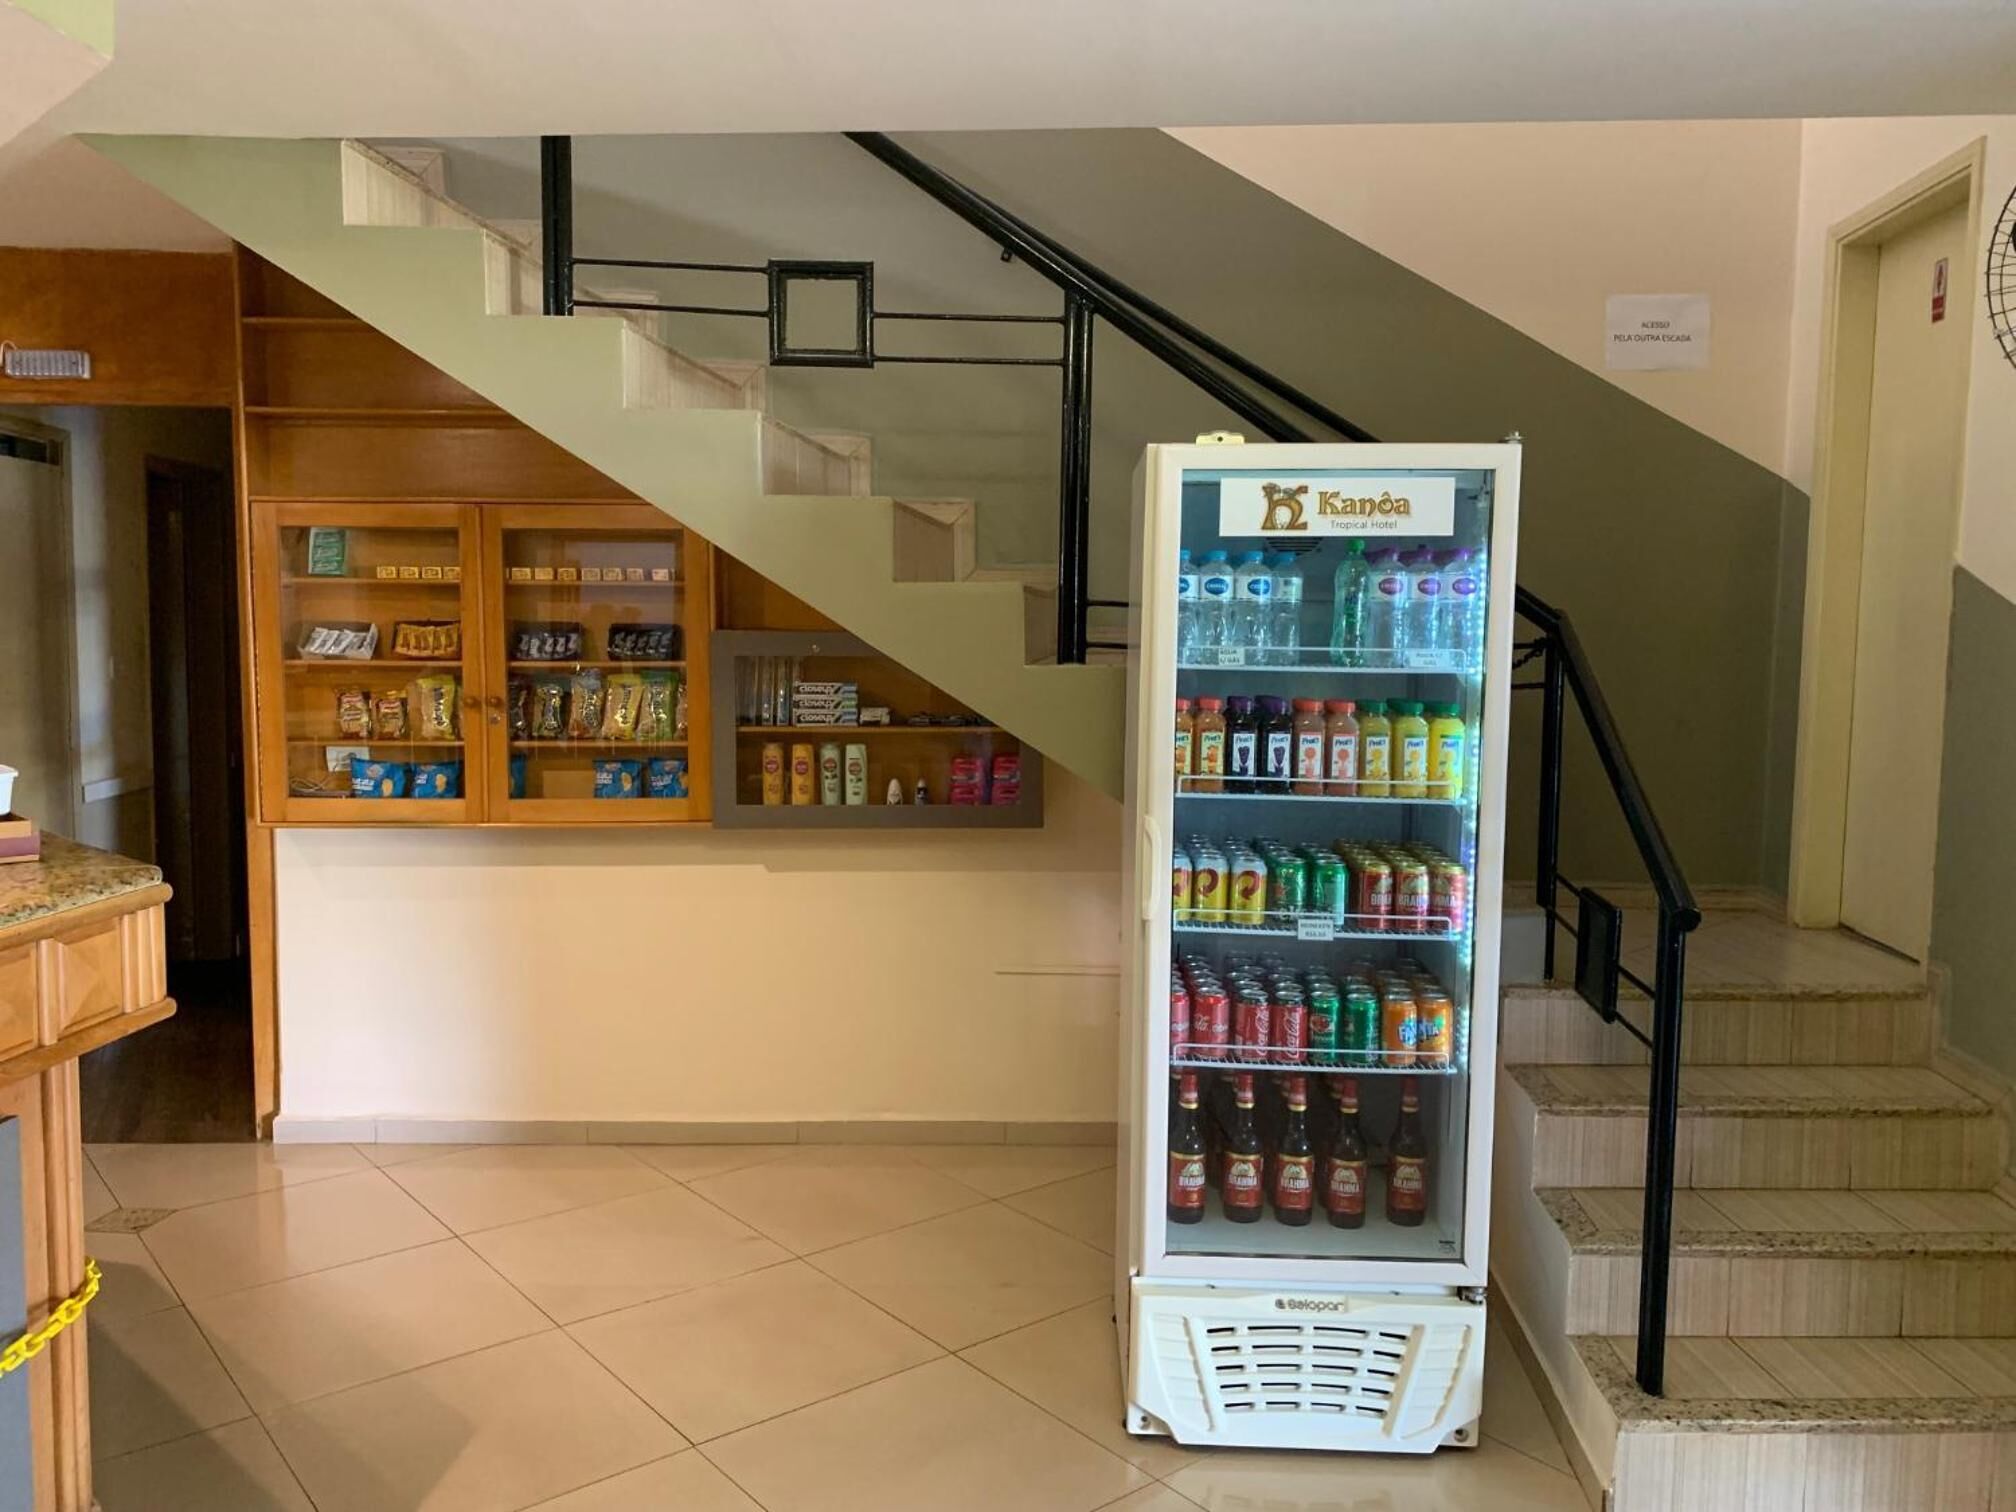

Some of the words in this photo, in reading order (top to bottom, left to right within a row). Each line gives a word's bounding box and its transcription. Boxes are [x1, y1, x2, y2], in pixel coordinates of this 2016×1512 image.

[1641, 321, 1671, 329] ACESSO
[1613, 334, 1633, 342] PELA
[1634, 334, 1660, 342] OUTRA
[1662, 334, 1692, 342] ESCADA
[1317, 490, 1411, 517] Kanôa
[1331, 520, 1368, 530] Tropical
[1371, 520, 1398, 530] Hotel
